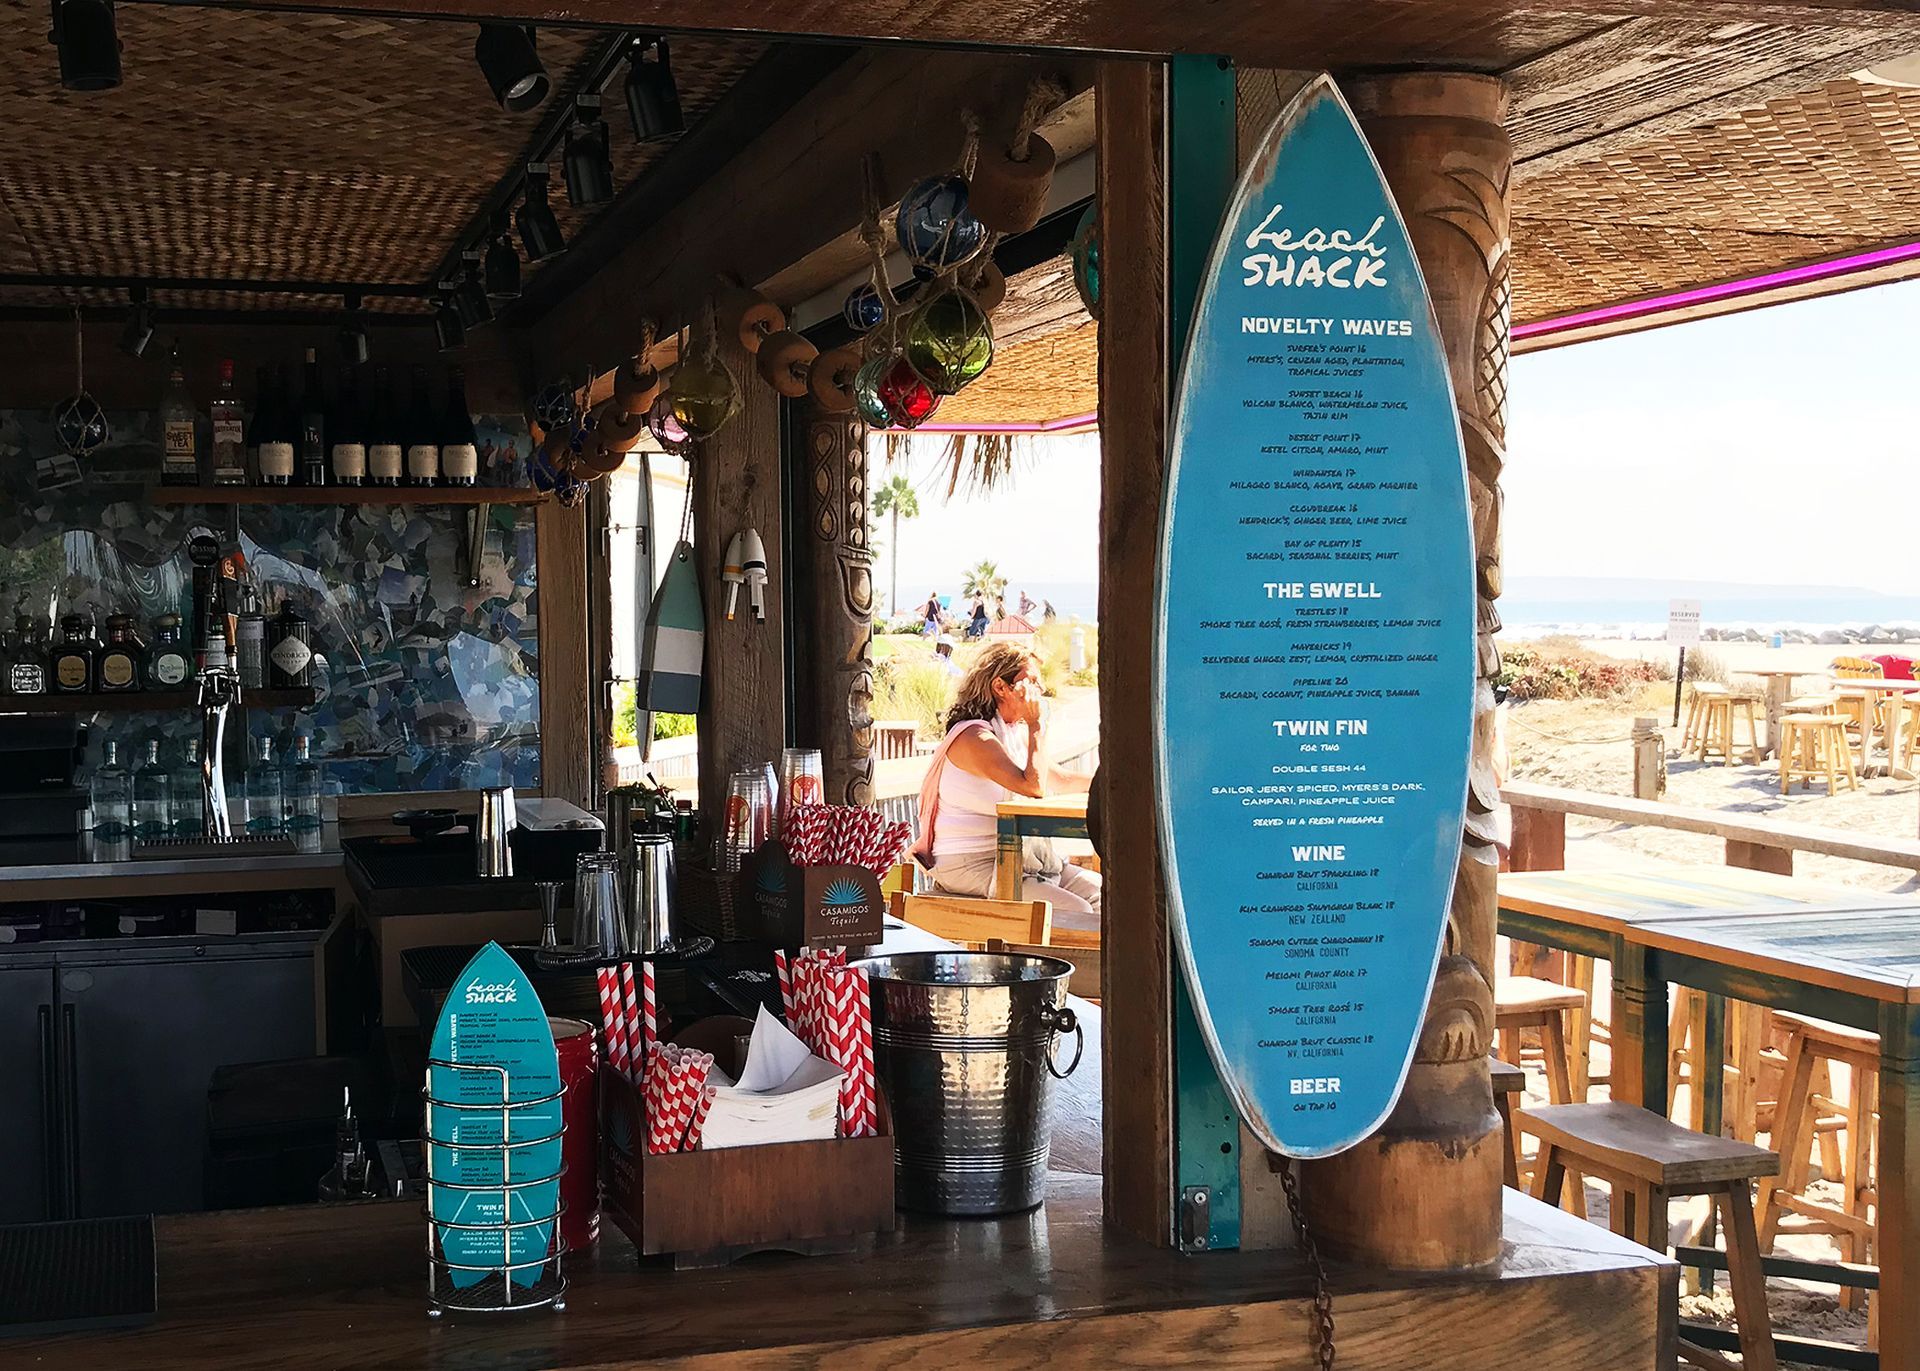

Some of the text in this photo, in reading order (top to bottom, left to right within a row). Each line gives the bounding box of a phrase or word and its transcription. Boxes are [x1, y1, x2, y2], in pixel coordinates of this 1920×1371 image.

[1246, 204, 1388, 257] beach
[1242, 253, 1388, 288] SHACK
[1242, 317, 1412, 336] NOVELTY WAVES
[1287, 344, 1327, 353] SURFER'S
[1358, 345, 1366, 353] 16
[1324, 357, 1349, 366] AGED,
[1352, 357, 1405, 367] PLANTATION,
[1288, 368, 1330, 376] TROPICAL
[1354, 390, 1363, 399] 16
[1279, 400, 1315, 409] BLANCO,
[1381, 402, 1408, 410] JUICE,
[1351, 433, 1361, 442] 17
[1291, 446, 1324, 455] CITRON,
[1327, 446, 1361, 455] AMARO,
[1346, 468, 1356, 477] 17
[1229, 481, 1270, 489] MILAGRO
[1274, 481, 1310, 491] BLANCO,
[1347, 482, 1376, 490] GRAND
[1349, 504, 1358, 512] 16
[1294, 517, 1326, 525] GINGER
[1303, 540, 1316, 548] OF
[1318, 540, 1350, 548] PLENTY
[1352, 539, 1362, 548] 15
[1246, 552, 1284, 561] BACARDI,
[1335, 552, 1372, 561] BERRIES,
[1263, 583, 1382, 598] THE SWELL
[1295, 607, 1348, 616] TRESTLES 18
[1286, 620, 1312, 628] FRESH
[1314, 620, 1379, 628] STRAWBERRIES,
[1343, 642, 1352, 650] 19
[1202, 656, 1250, 664] BELVEDERE
[1289, 655, 1311, 664] ZEST,
[1219, 691, 1258, 700] BACARDI,
[1262, 690, 1303, 699] COCONUT,
[1356, 690, 1382, 698] JUICE,
[1273, 720, 1367, 736] TWIN FIN
[1299, 797, 1359, 805] PINEAPPLE
[1308, 817, 1334, 825] FRESH
[1338, 816, 1384, 824] PINEAPPLE
[1292, 846, 1345, 861] WINE
[1297, 870, 1320, 879] BRUT
[1322, 870, 1368, 878] SPARKLING
[1370, 868, 1379, 877] 18
[1297, 881, 1338, 891] CALIFORNIA
[820, 905, 869, 916] CASAMIGOS
[1239, 905, 1258, 914] KIM
[1260, 905, 1305, 913] CRAWFORD
[1356, 902, 1383, 910] BLANC
[1289, 914, 1345, 925] NEW ZEALAND
[1375, 934, 1384, 943] 18
[1320, 947, 1349, 957] COUNTY
[1304, 970, 1331, 978] PINOT
[1358, 968, 1368, 976] 17
[1296, 981, 1337, 991] CALIFORNIA
[465, 992, 517, 1004] SHACK
[1268, 1006, 1300, 1014] SMOKE
[1303, 1005, 1325, 1013] TREE
[1354, 1003, 1364, 1011] 15
[1296, 1016, 1336, 1025] CALIFORNIA
[1300, 1037, 1325, 1046] BRUT
[1326, 1037, 1361, 1045] CLASSIC
[1364, 1035, 1374, 1043] 18
[1302, 1048, 1344, 1058] CALIFORNIA
[1290, 1078, 1340, 1094] BEER
[1308, 1102, 1325, 1111] TAP
[1327, 1101, 1336, 1110] 10
